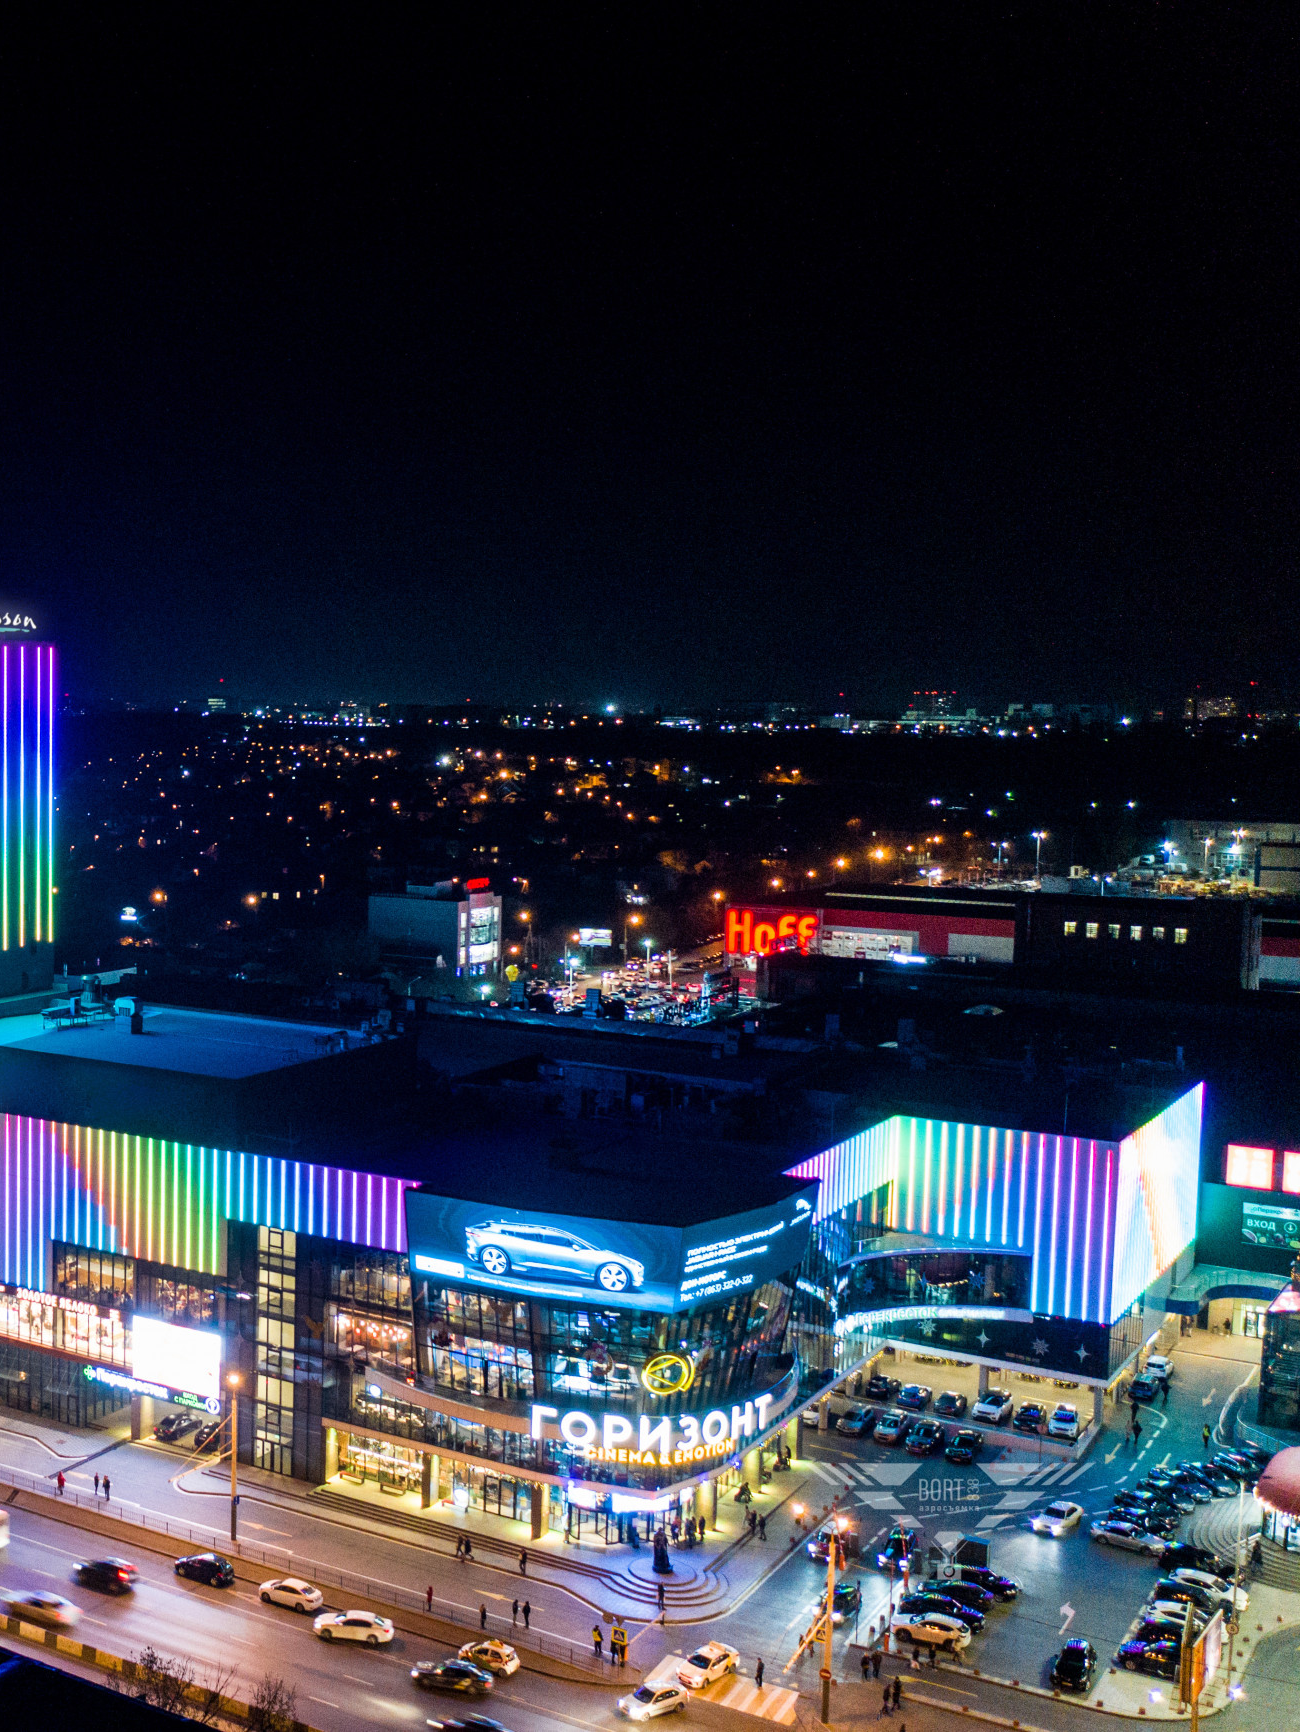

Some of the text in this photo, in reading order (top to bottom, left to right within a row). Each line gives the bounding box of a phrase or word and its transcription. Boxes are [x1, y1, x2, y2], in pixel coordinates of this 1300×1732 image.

[726, 908, 819, 956] Hoff
[1247, 1218, 1276, 1231] ВХОД
[16, 1287, 98, 1316] ЗОЛОТОЕ ЯБЛОКО
[530, 1393, 773, 1453] ГОРИЗОНТ
[585, 1438, 736, 1466] CINEMA & EMOTION
